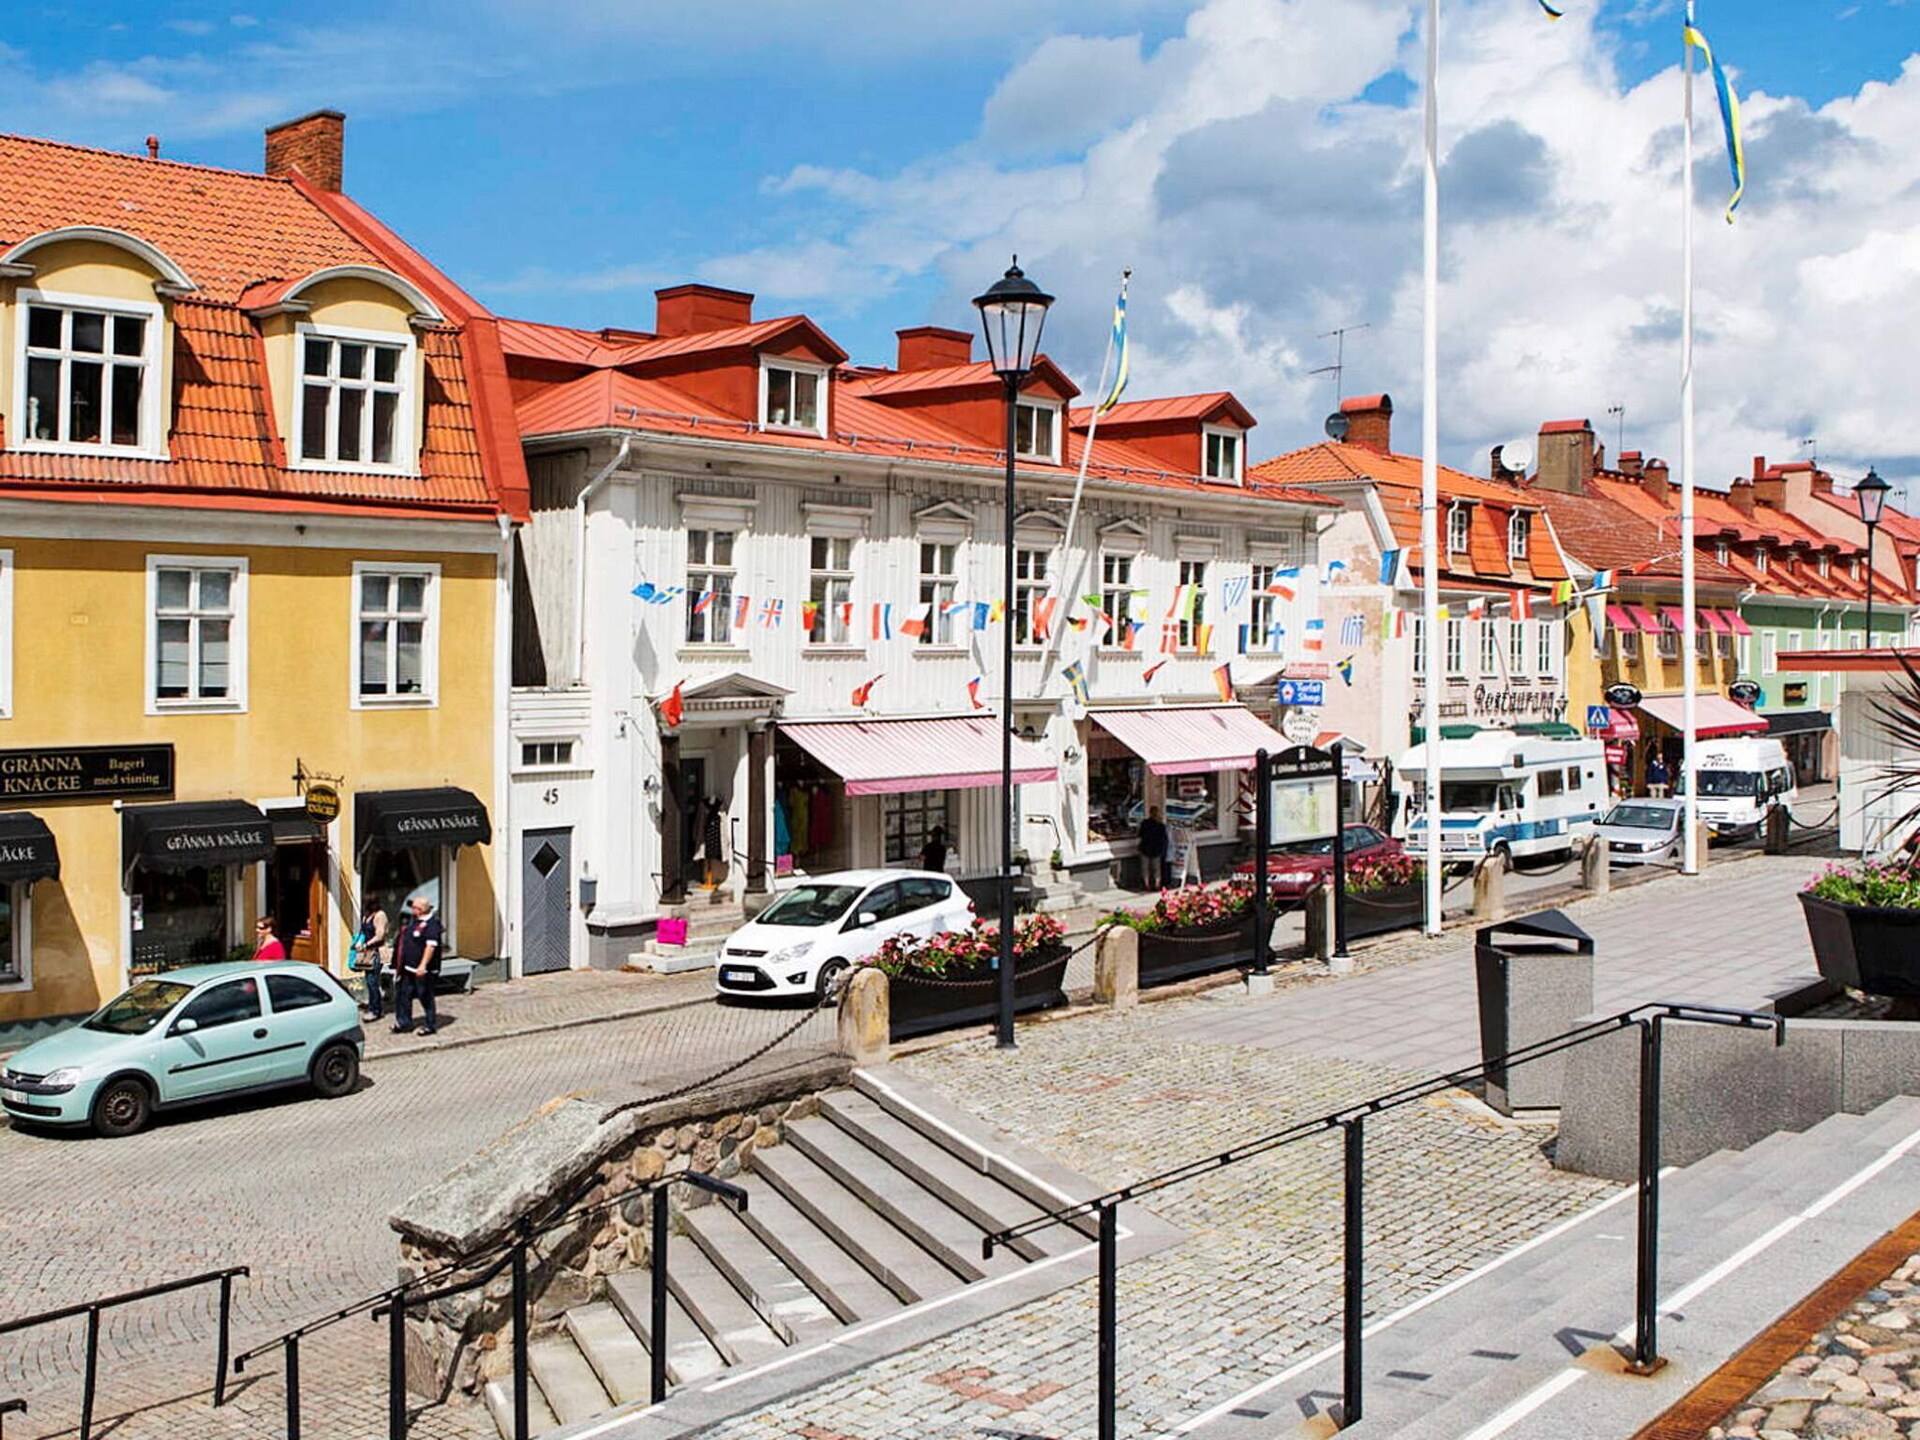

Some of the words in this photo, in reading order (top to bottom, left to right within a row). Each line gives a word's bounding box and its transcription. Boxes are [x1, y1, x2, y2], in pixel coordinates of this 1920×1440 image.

[1474, 684, 1555, 721] Restaurang
[2, 753, 82, 773] GRÄNNA
[109, 758, 145, 771] Bageri
[4, 774, 82, 793] KNÄCKE
[94, 775, 118, 786] med
[121, 773, 160, 786] visning
[543, 788, 558, 805] 45
[396, 817, 440, 832] GRÄNNA
[440, 814, 479, 829] KNÄCKE
[166, 834, 215, 850] GRÄNNA
[217, 830, 263, 846] KNÄCKE
[0, 846, 36, 861] ÄCKE
